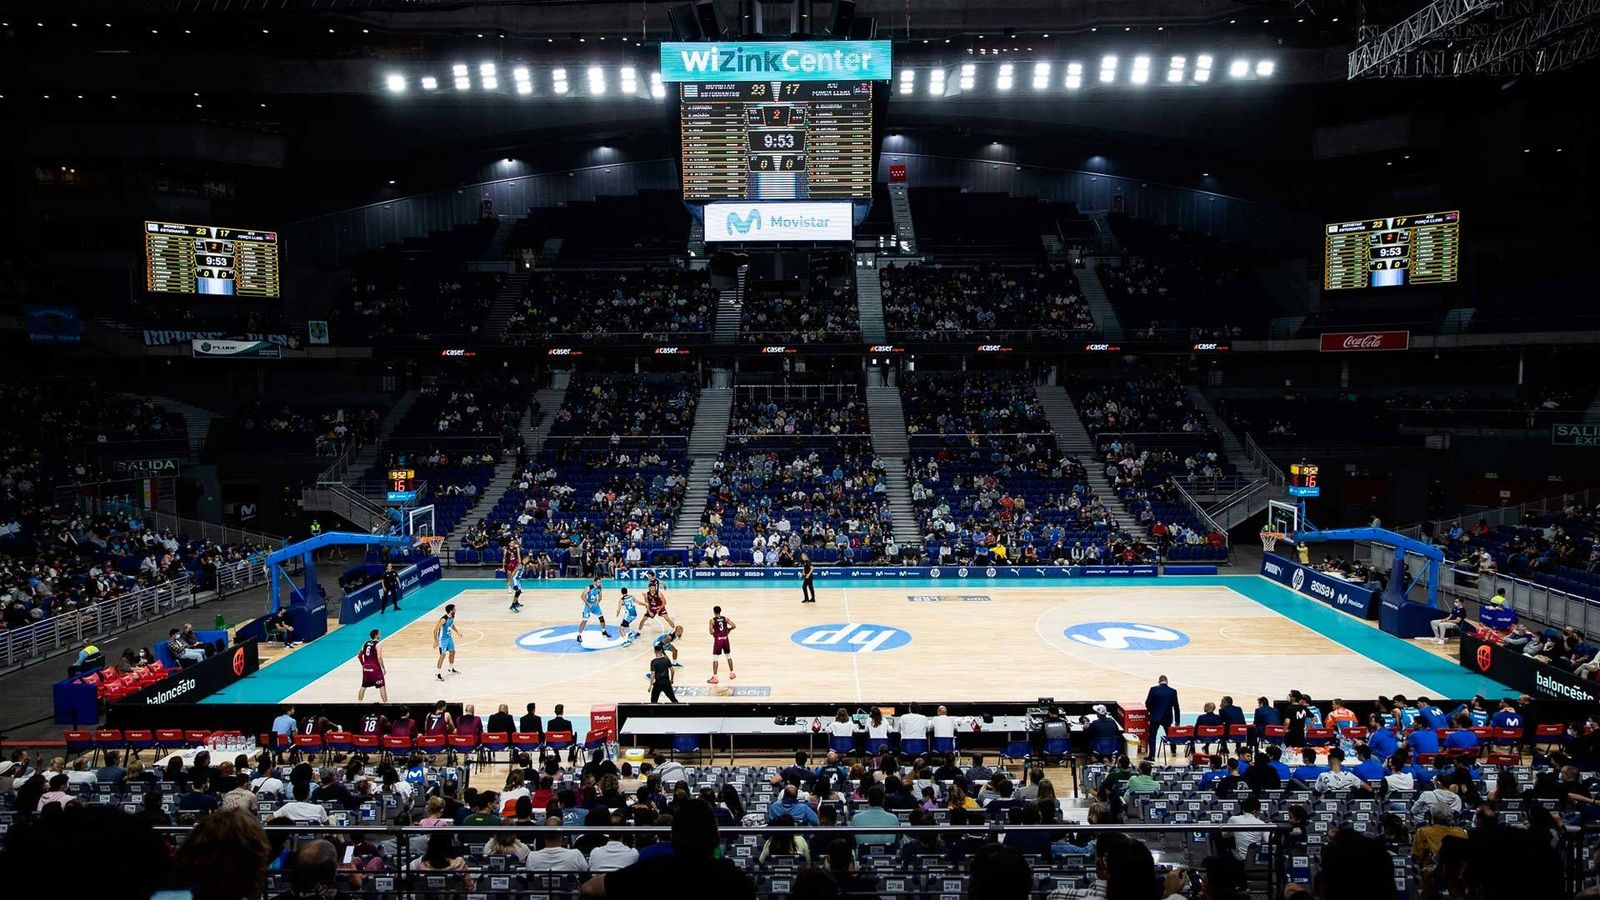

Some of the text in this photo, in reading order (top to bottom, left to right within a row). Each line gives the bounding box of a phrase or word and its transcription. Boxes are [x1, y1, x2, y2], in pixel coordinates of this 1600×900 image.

[751, 84, 766, 95] 23
[785, 83, 800, 94] 17
[773, 109, 781, 119] 2
[764, 133, 795, 148] 9:53
[760, 159, 768, 170] 0
[785, 159, 794, 170] 0
[771, 215, 830, 228] Movistar
[1372, 220, 1383, 228] 23
[1396, 218, 1407, 226] 17
[196, 227, 207, 236] 23
[1380, 247, 1402, 257] 9:53
[205, 256, 227, 266] 9:53
[766, 345, 785, 353] caser
[394, 479, 405, 492] 16
[1305, 475, 1317, 487] 16
[1310, 580, 1329, 597] asisa
[718, 621, 724, 631] 3
[305, 723, 313, 735] 0
[364, 720, 377, 732] 18
[431, 718, 438, 730] 7
